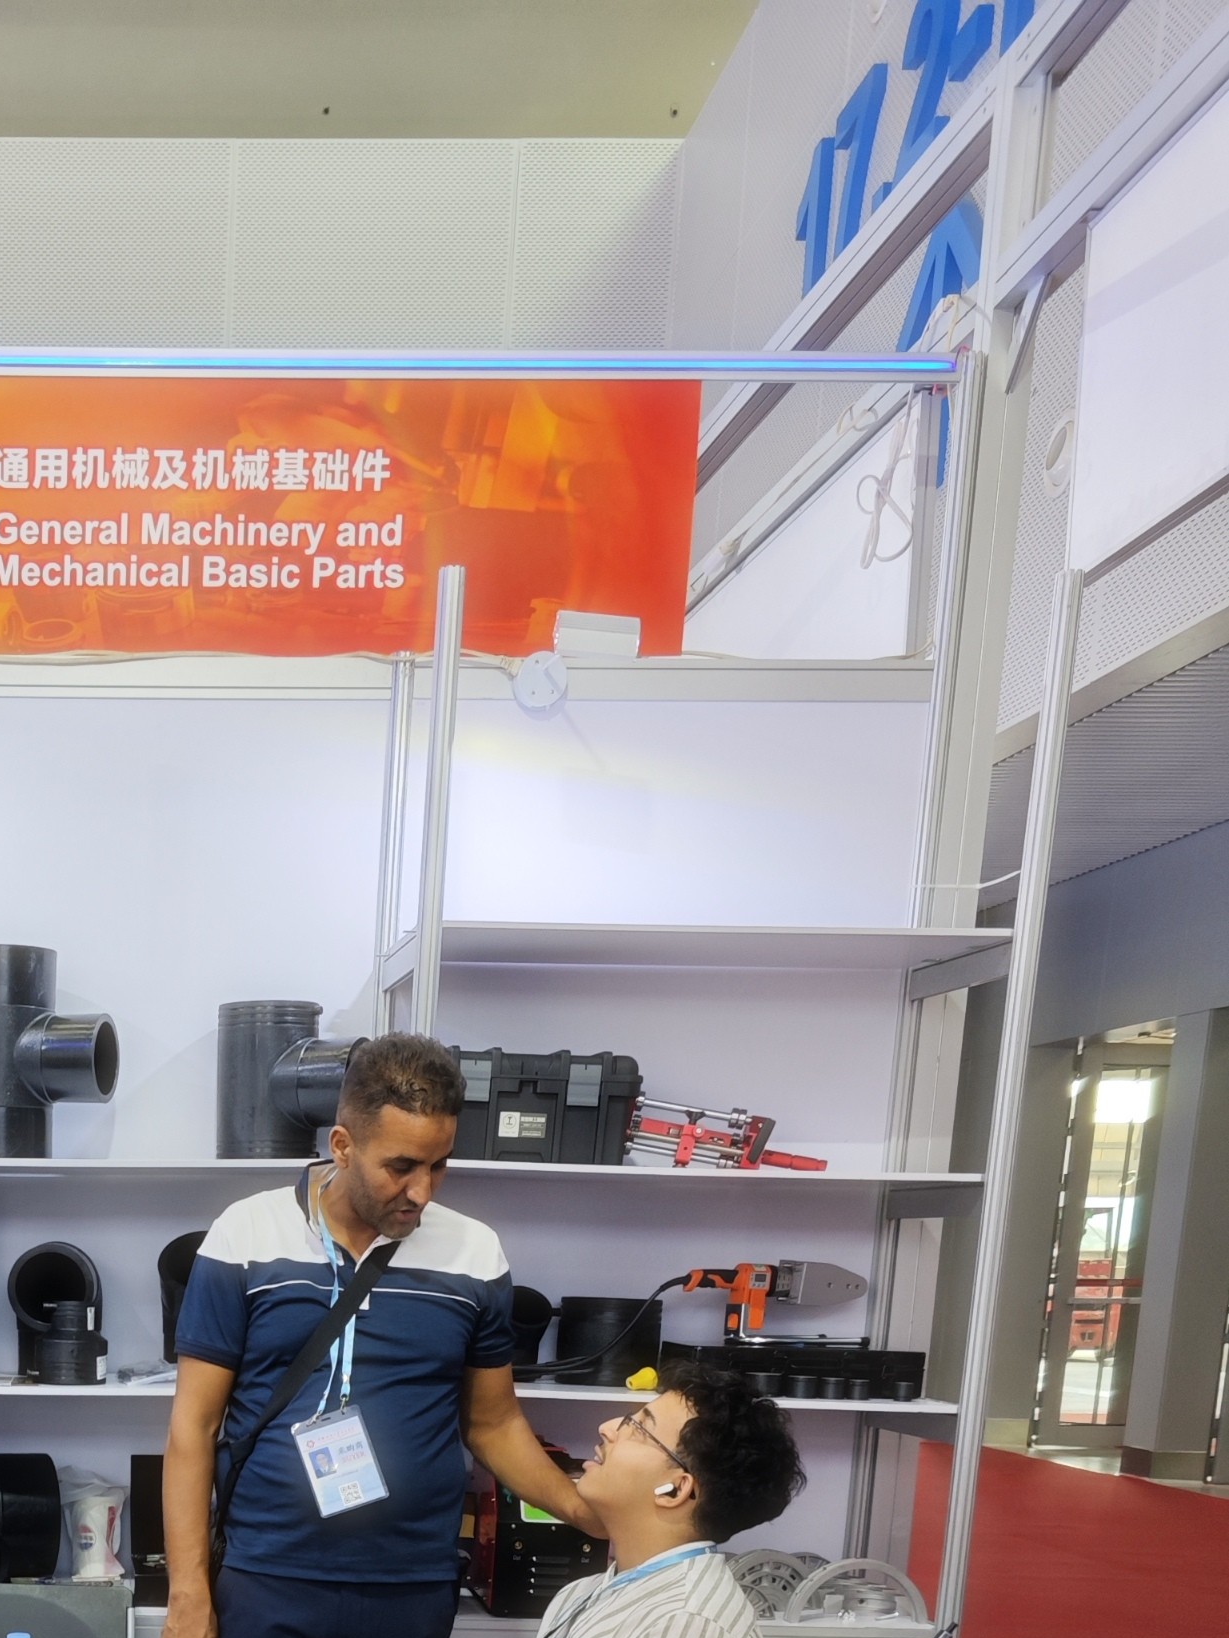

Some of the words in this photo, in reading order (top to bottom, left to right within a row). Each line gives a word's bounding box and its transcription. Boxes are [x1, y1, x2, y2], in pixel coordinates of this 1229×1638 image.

[141, 512, 325, 555] Machinery
[336, 515, 403, 546] and
[202, 556, 300, 588] Basic
[312, 557, 405, 589] Parts
